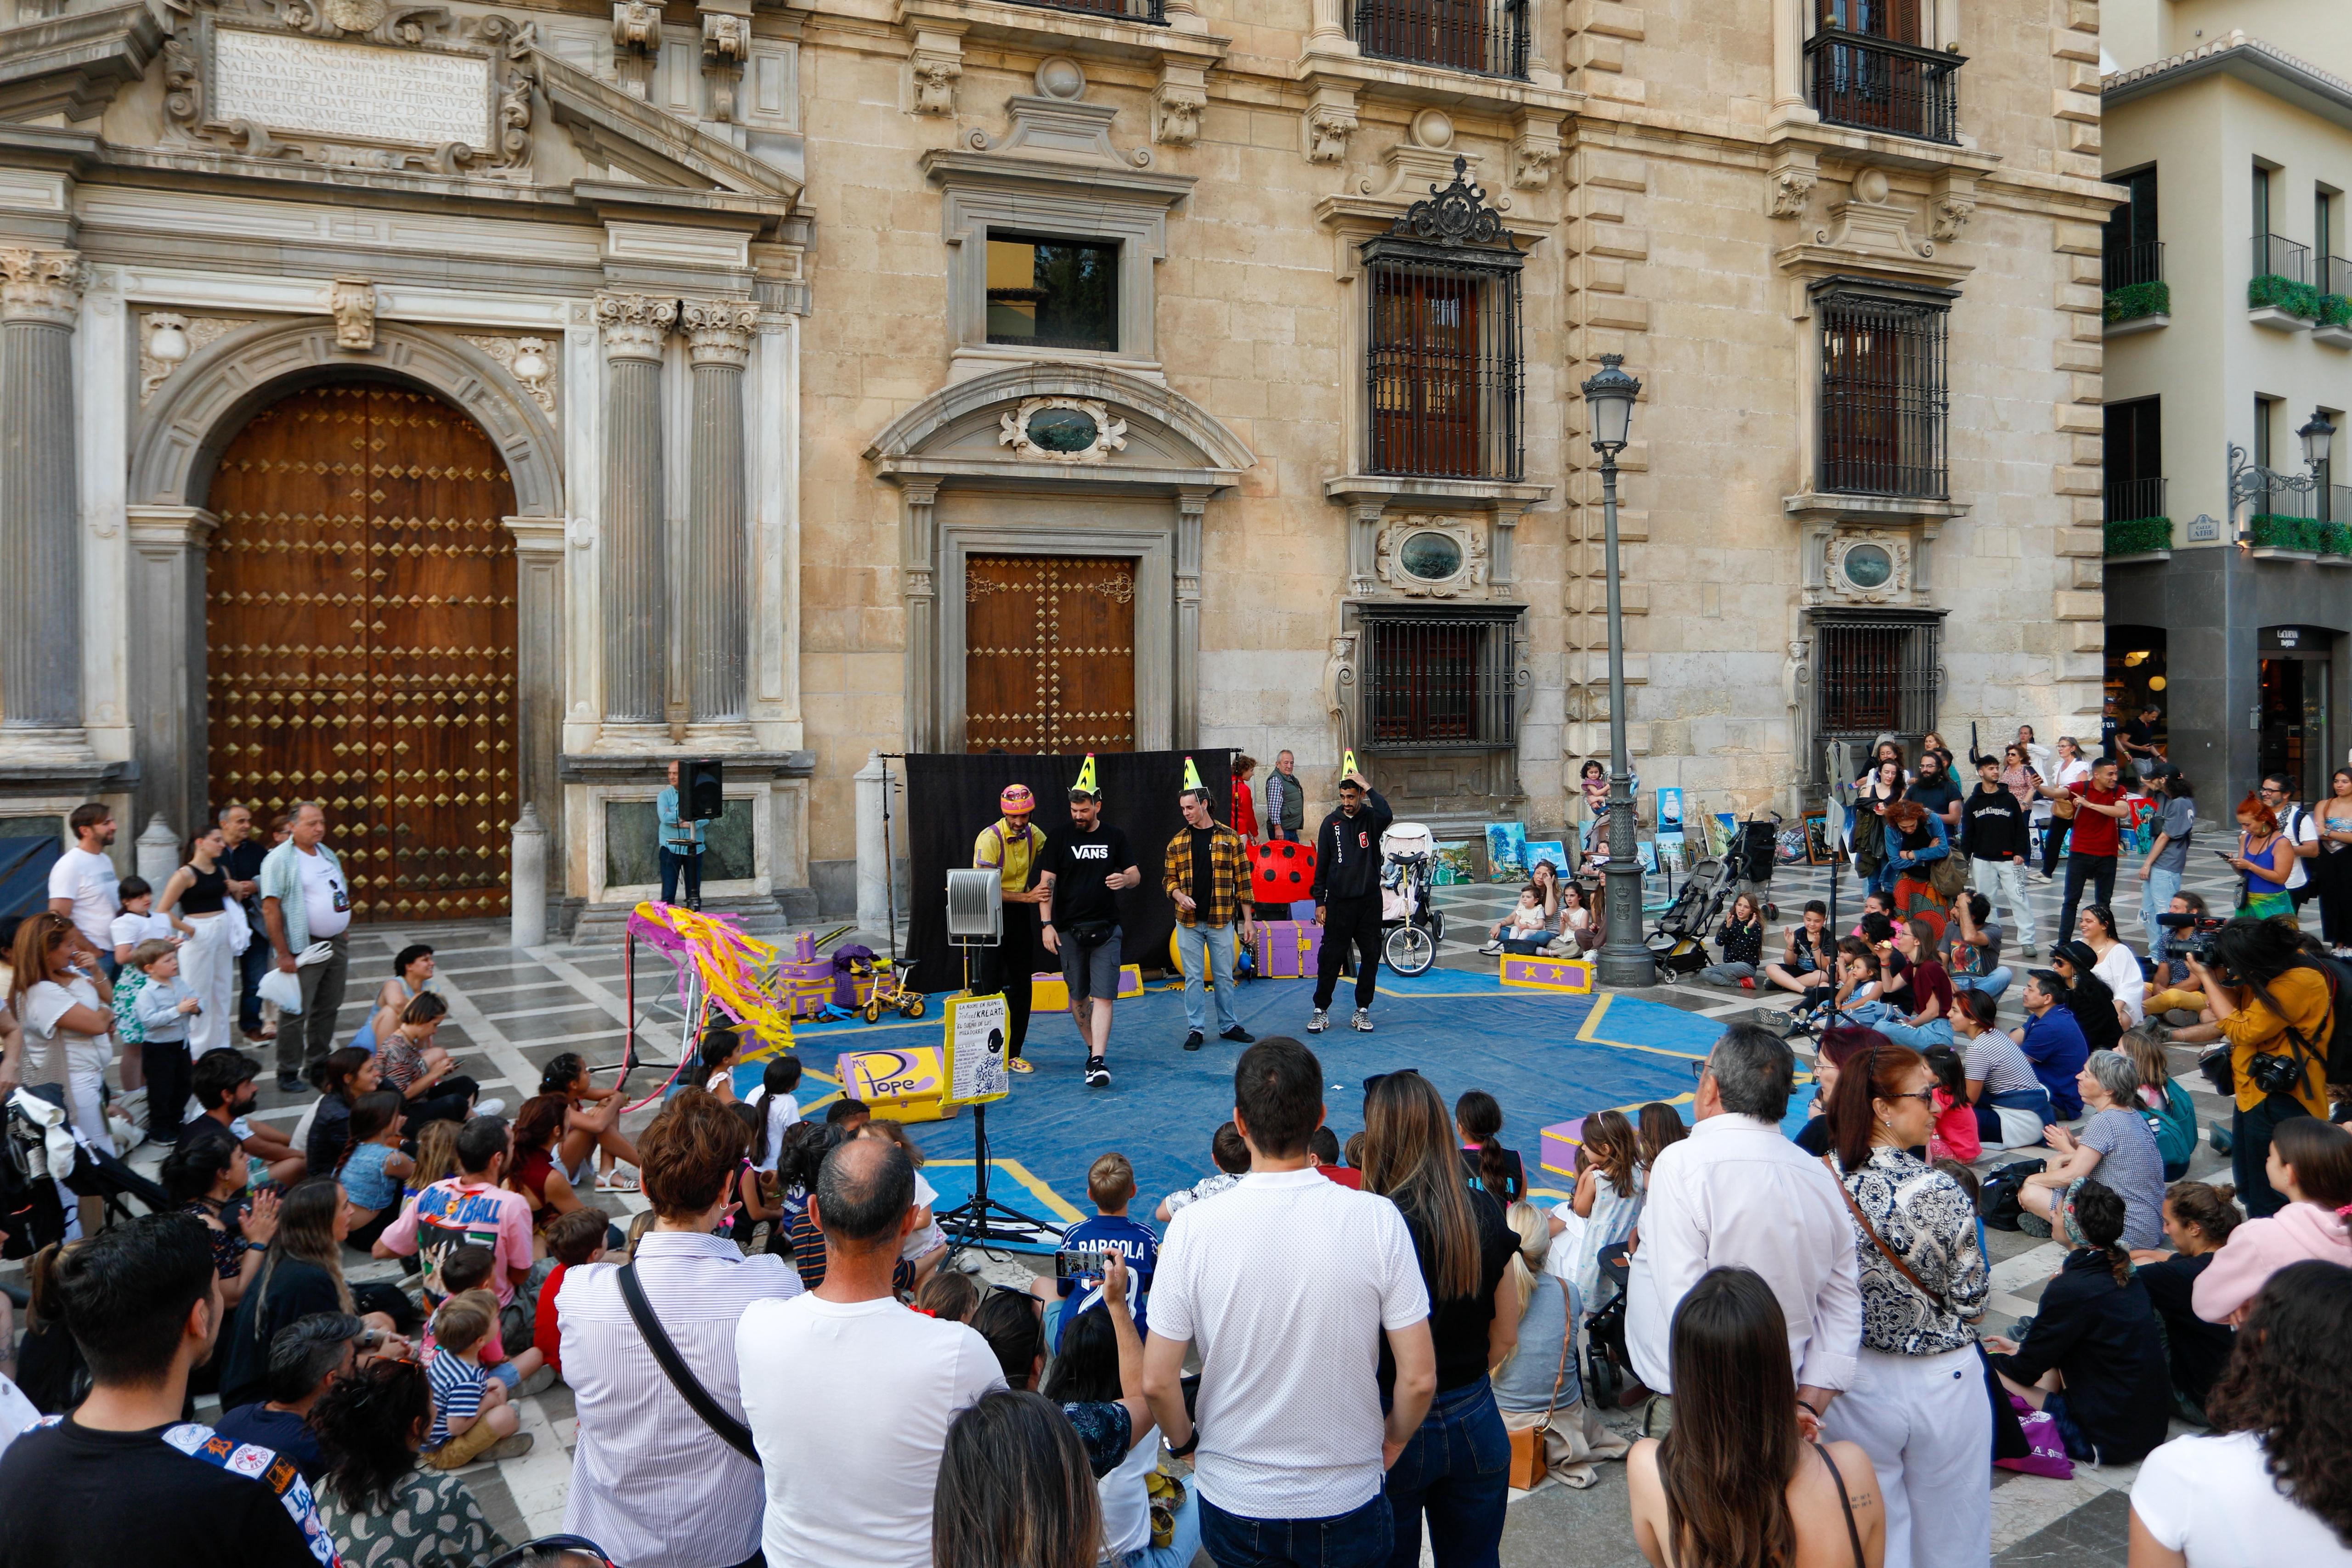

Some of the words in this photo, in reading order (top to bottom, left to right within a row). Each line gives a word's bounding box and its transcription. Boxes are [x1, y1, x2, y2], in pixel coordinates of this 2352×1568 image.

[1985, 807, 2010, 817] Angeles
[1071, 845, 1108, 859] VANS
[977, 1008, 1004, 1018] KREARTE
[459, 1196, 502, 1224] BALL
